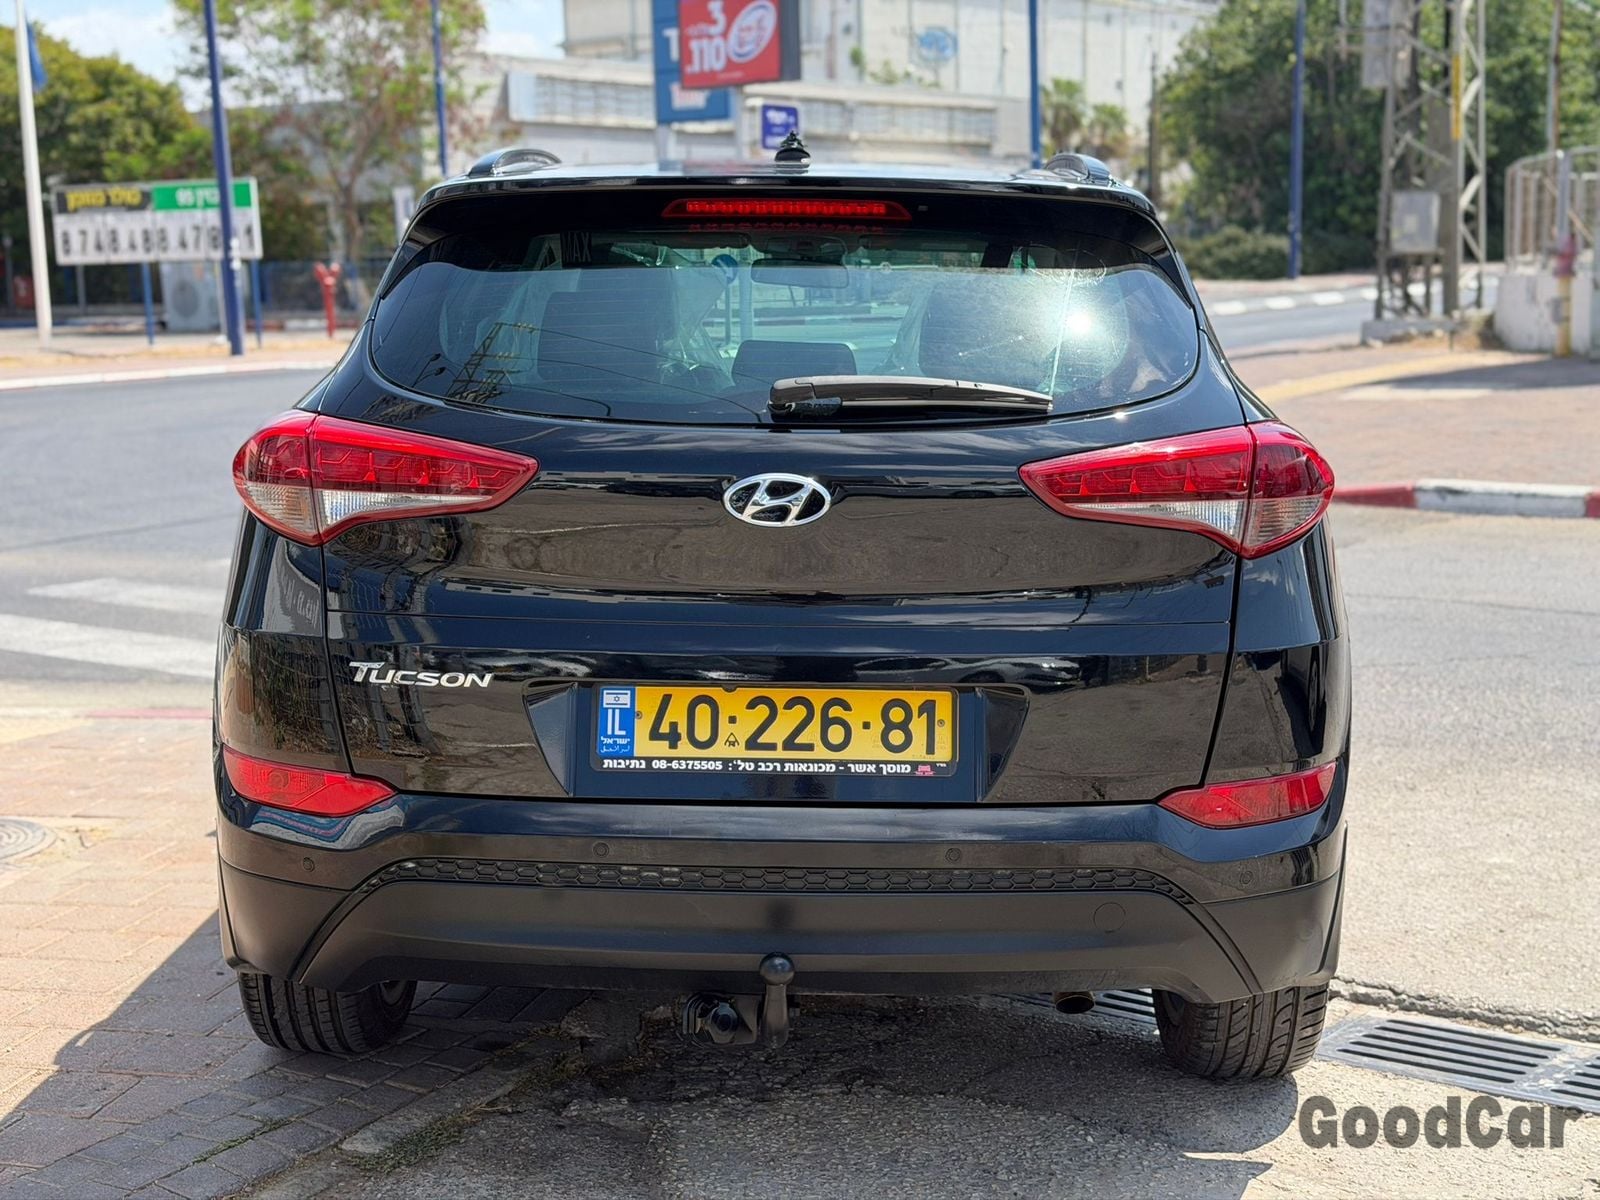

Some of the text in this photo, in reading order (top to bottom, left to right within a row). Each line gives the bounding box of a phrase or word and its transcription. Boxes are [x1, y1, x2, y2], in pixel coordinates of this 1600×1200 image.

[350, 661, 493, 688] TUCSON
[607, 708, 626, 735] IL
[600, 736, 631, 745] ישראל
[602, 759, 646, 769] נתיבות
[651, 759, 723, 770] 08-6375505
[757, 762, 781, 772] רכב
[783, 762, 836, 772] מכונאות
[847, 763, 876, 773] אשר
[879, 763, 911, 775] מוסך
